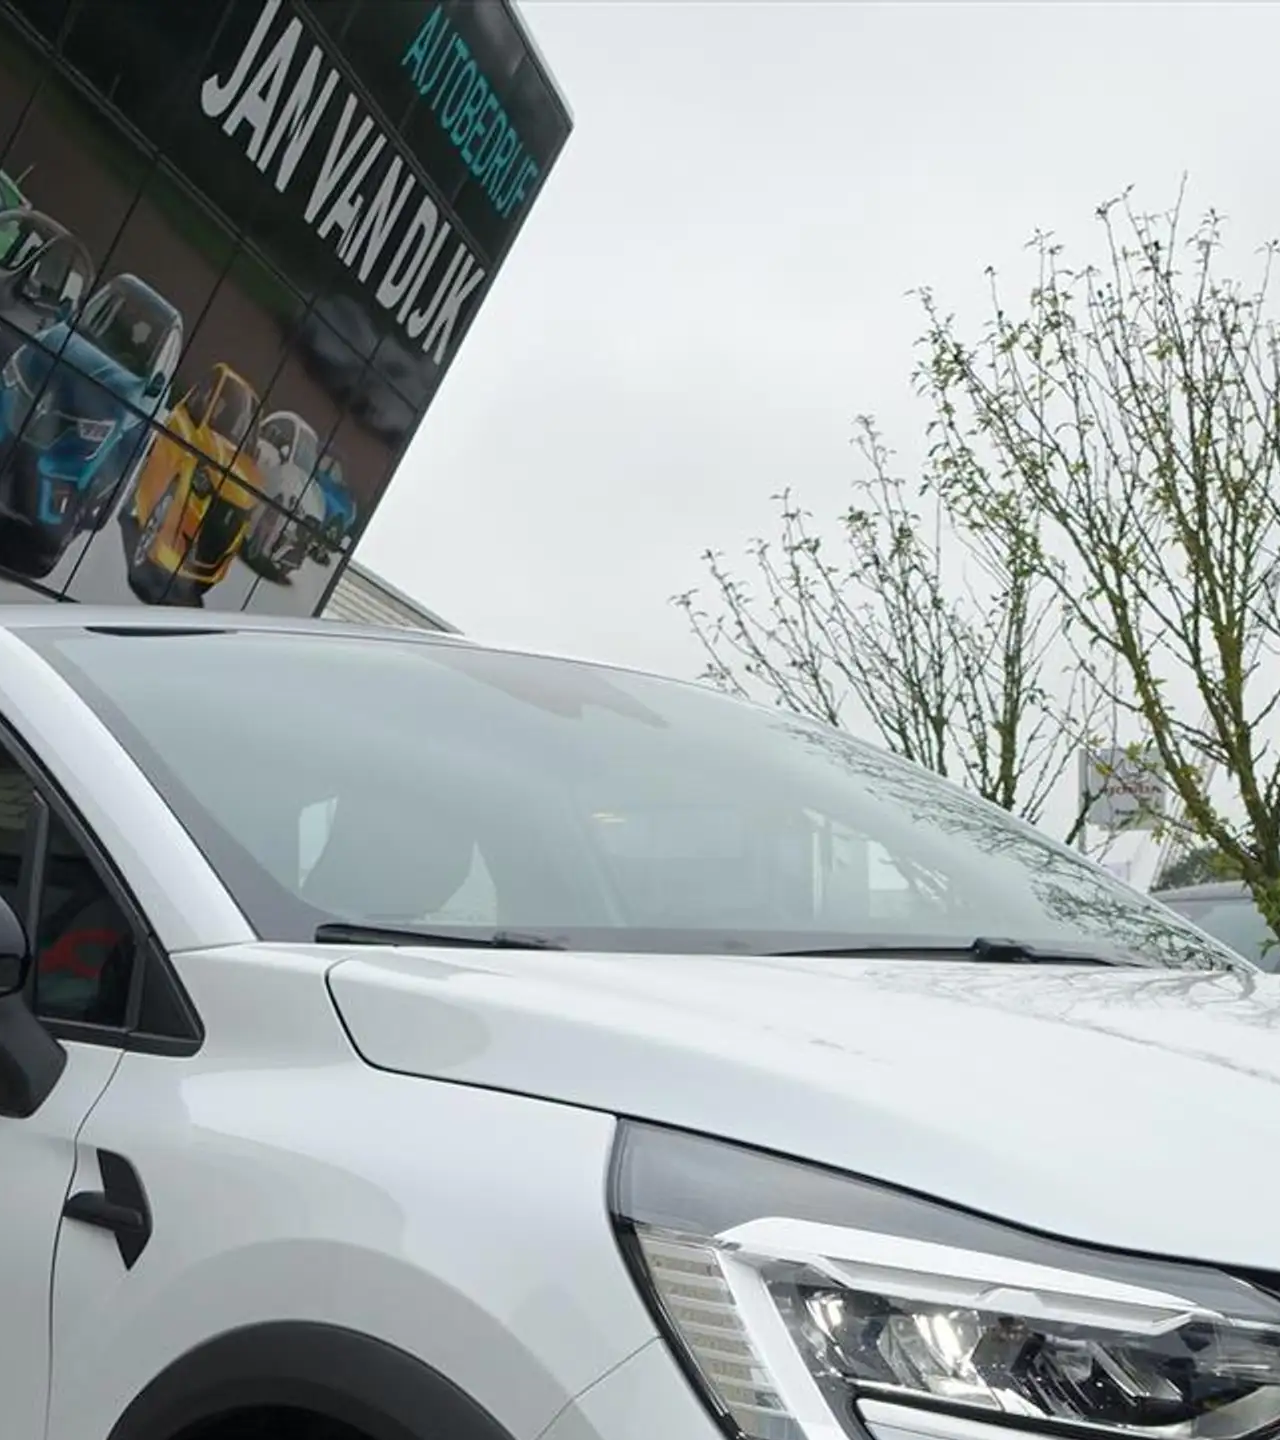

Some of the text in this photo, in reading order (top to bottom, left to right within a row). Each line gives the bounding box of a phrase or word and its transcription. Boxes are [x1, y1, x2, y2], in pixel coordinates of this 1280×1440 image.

[201, 0, 486, 365] JAN VAN DIJK
[401, 5, 539, 219] AUTOBEDRIJF
